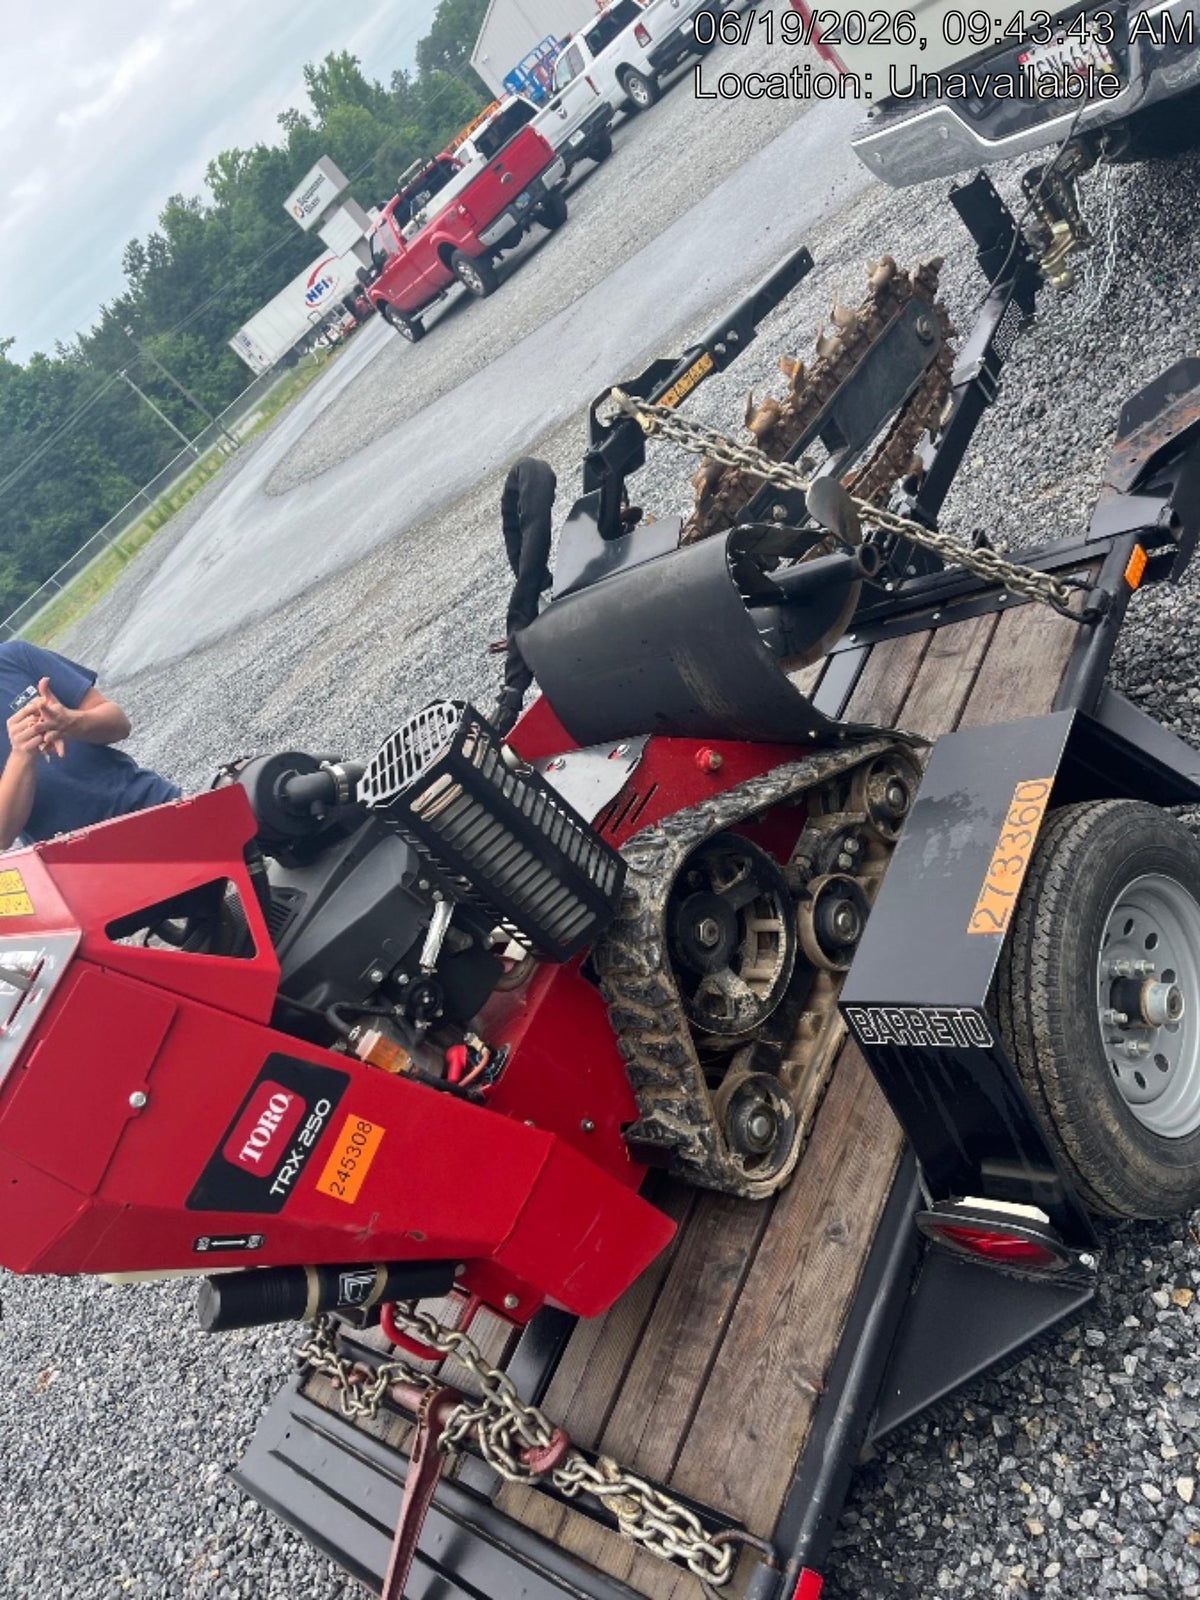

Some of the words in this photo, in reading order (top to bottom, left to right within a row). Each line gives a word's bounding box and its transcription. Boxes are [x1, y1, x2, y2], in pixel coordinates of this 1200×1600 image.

[305, 278, 330, 303] NFI
[972, 782, 1049, 929] 273360
[846, 1007, 995, 1048] BARRETO
[238, 1093, 289, 1163] TORO
[328, 1121, 373, 1196] 245308
